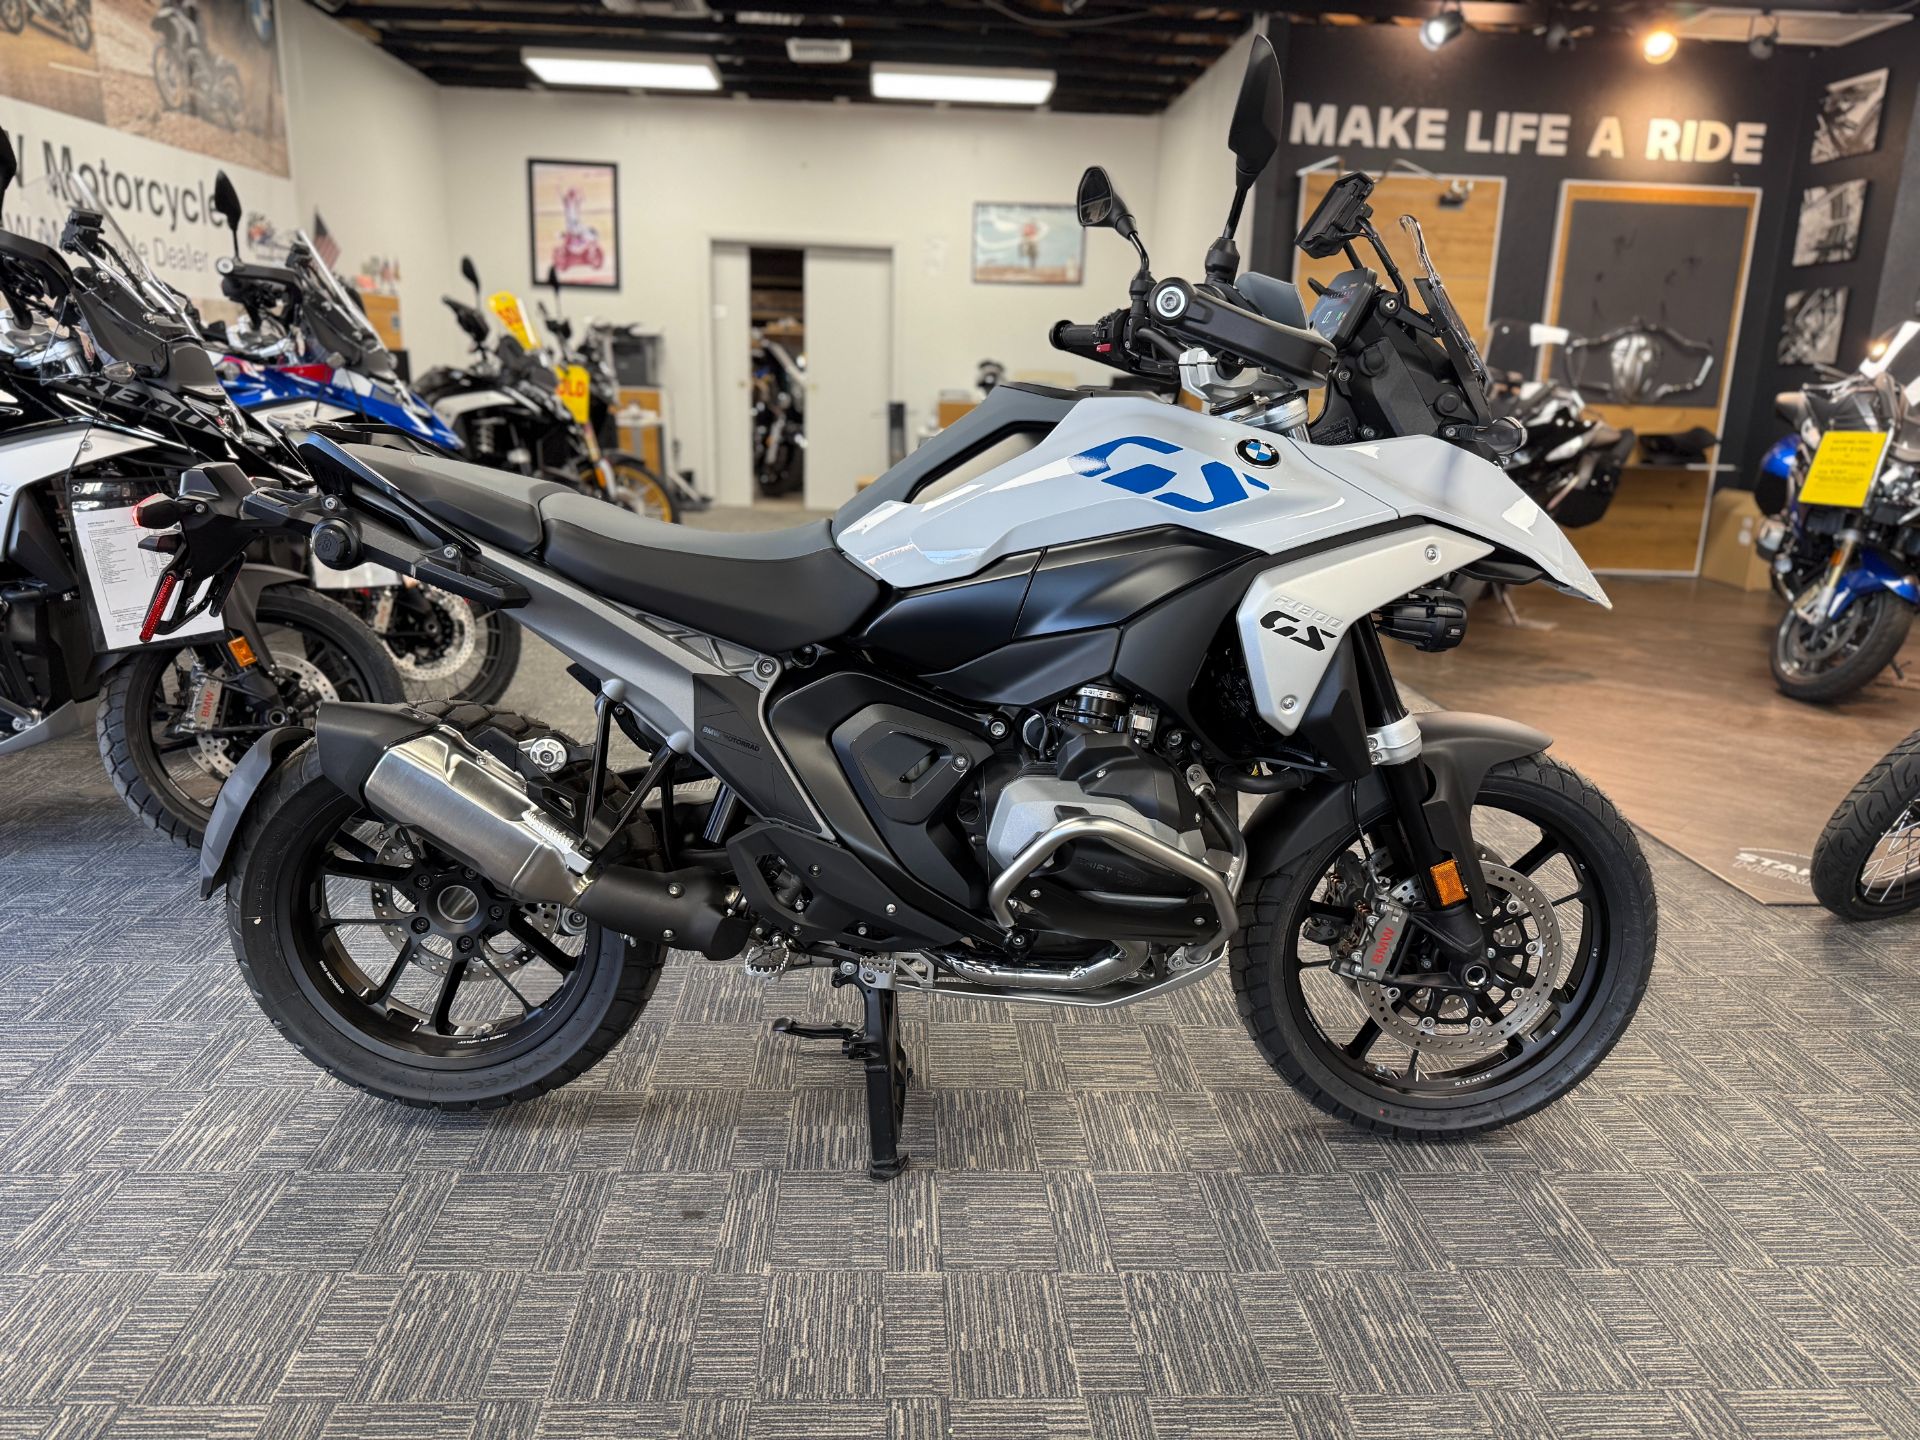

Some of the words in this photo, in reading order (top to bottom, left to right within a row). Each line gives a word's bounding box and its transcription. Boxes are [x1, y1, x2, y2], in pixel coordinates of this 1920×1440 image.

[1289, 103, 1448, 150] MAKE
[1465, 110, 1571, 156] LIFE
[1587, 116, 1625, 160] A
[1645, 118, 1767, 165] RIDE
[153, 236, 209, 274] Dealer
[1259, 610, 1338, 652] GS
[200, 690, 215, 718] BMW
[702, 725, 720, 738] BMW
[1371, 926, 1395, 965] BMW
